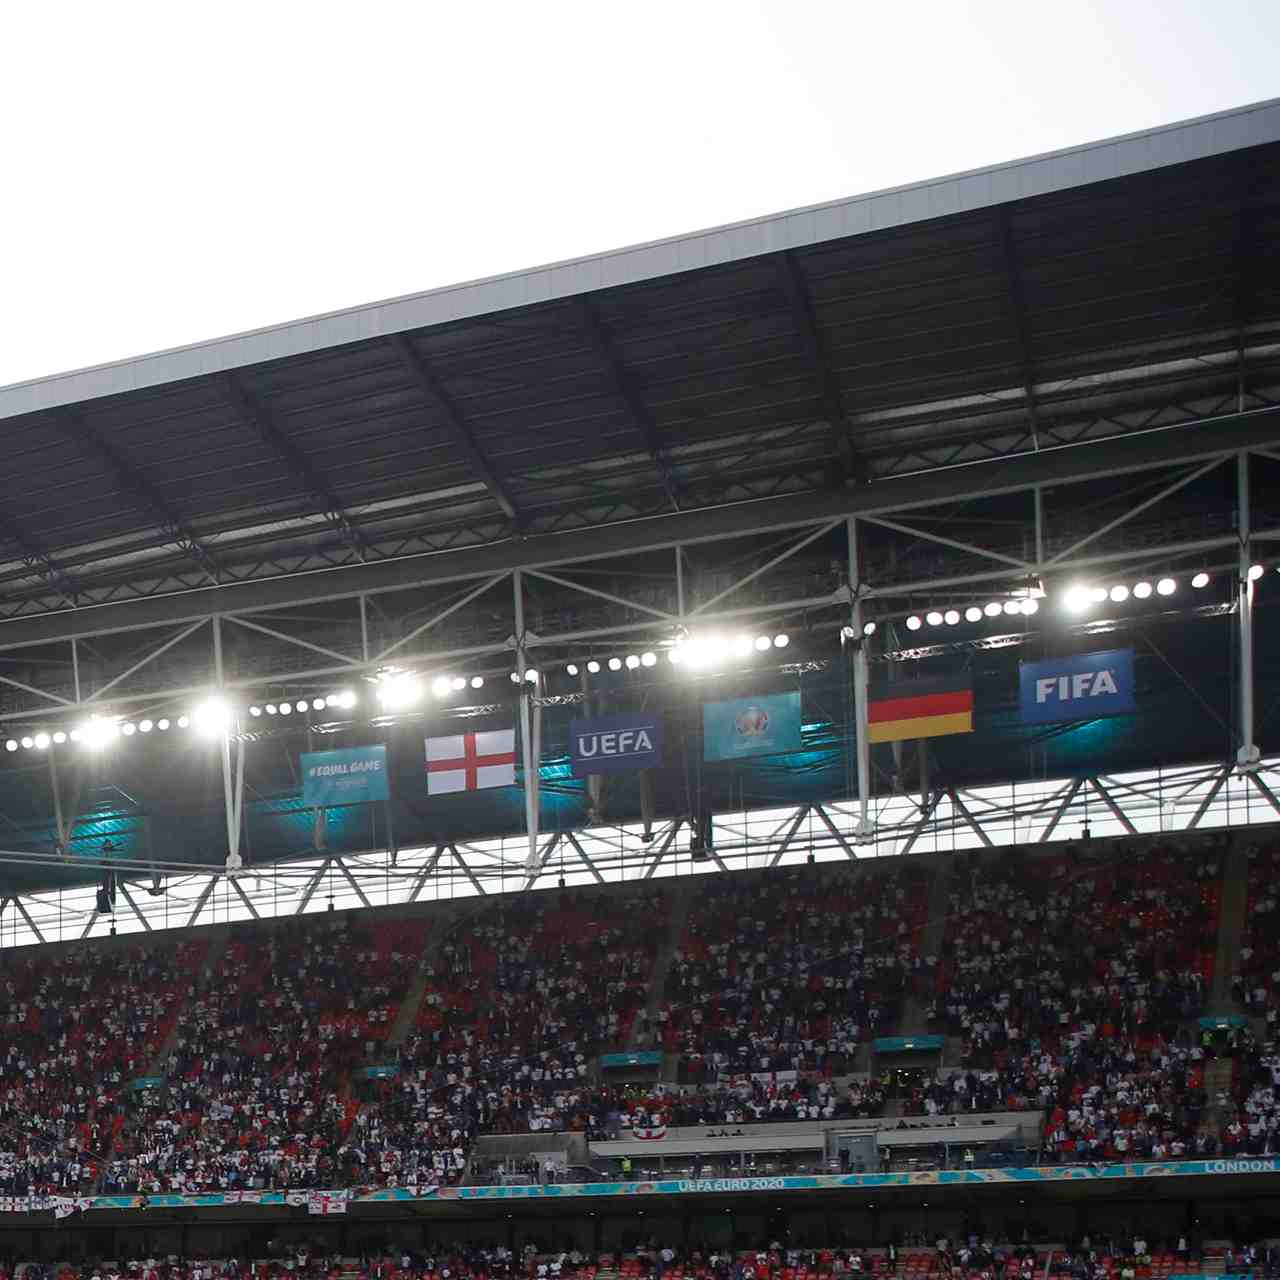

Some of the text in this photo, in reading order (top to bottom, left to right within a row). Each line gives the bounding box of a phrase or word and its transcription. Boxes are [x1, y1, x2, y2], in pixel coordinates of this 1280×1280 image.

[1036, 669, 1118, 704] FIFA
[579, 731, 653, 757] UEFA
[1205, 1160, 1275, 1173] LONDON
[679, 1179, 784, 1193] UEFA EURO 2020
